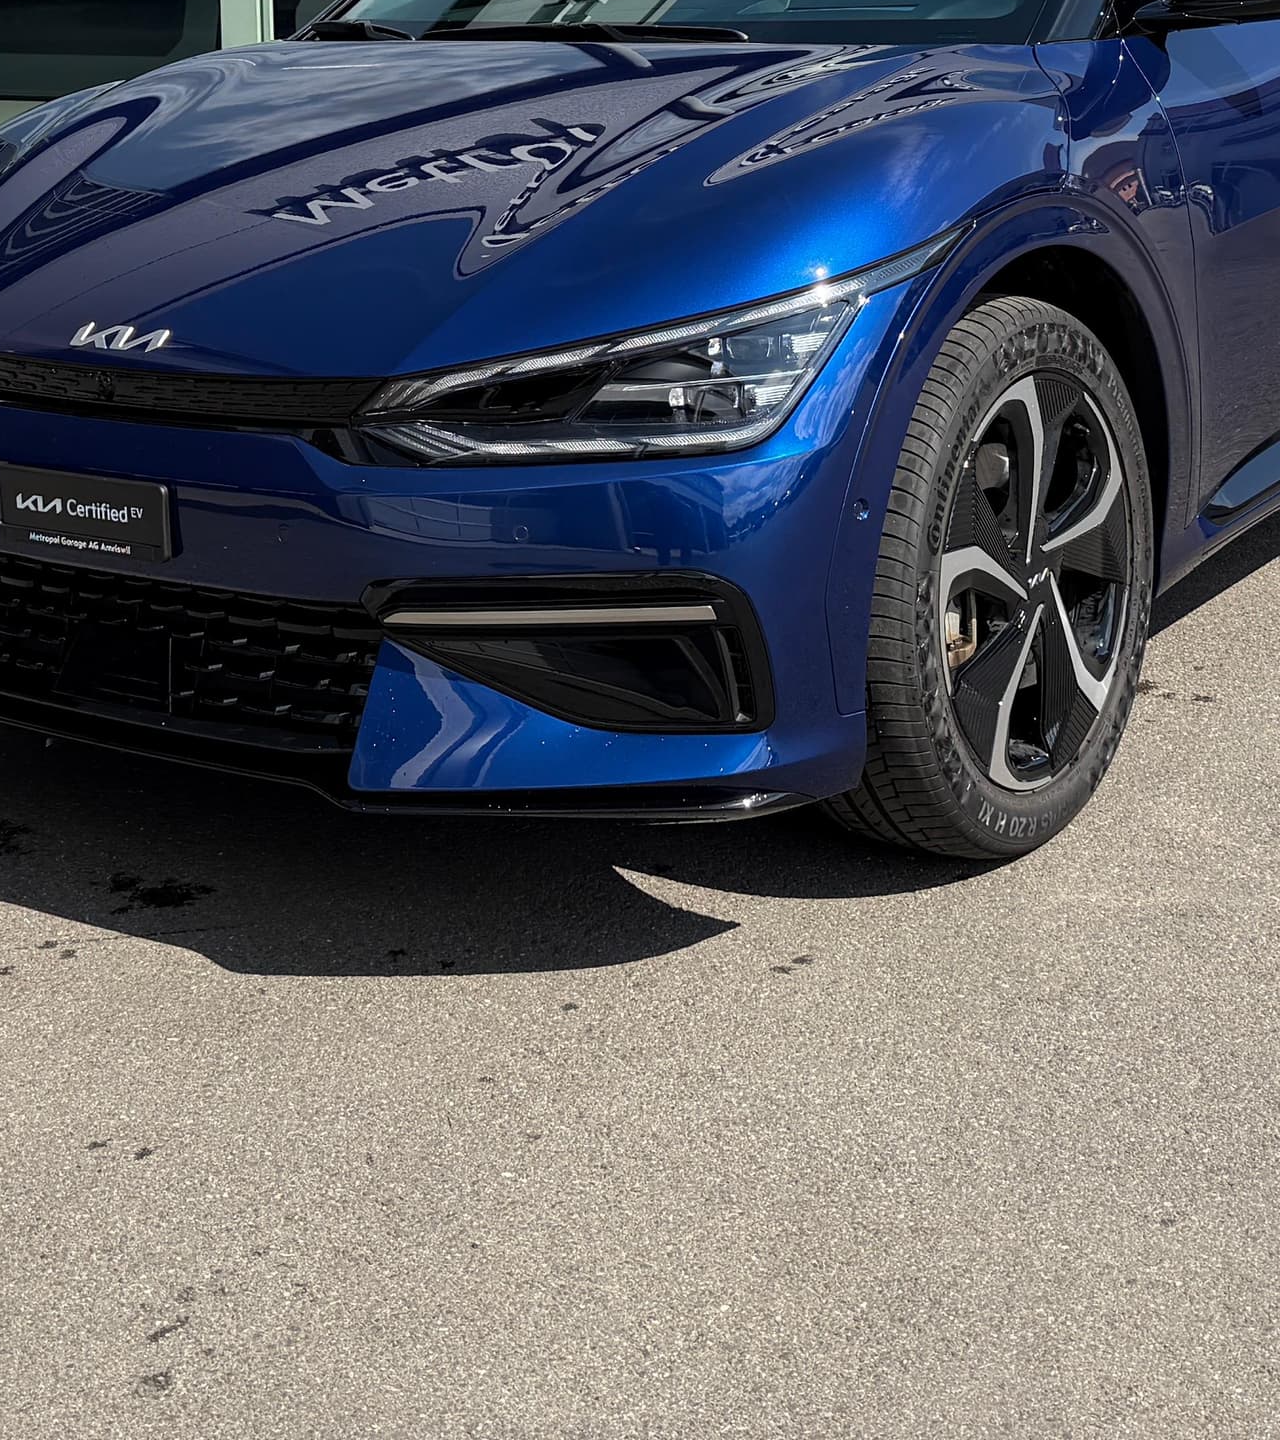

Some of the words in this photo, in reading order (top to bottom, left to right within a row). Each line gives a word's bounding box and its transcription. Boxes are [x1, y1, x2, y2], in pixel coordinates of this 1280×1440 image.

[70, 321, 170, 352] KIA
[16, 492, 62, 515] KIA
[66, 499, 128, 523] Certified
[131, 507, 143, 519] EV
[29, 531, 60, 545] Metropol
[61, 536, 87, 549] Garage
[88, 540, 99, 550] AG
